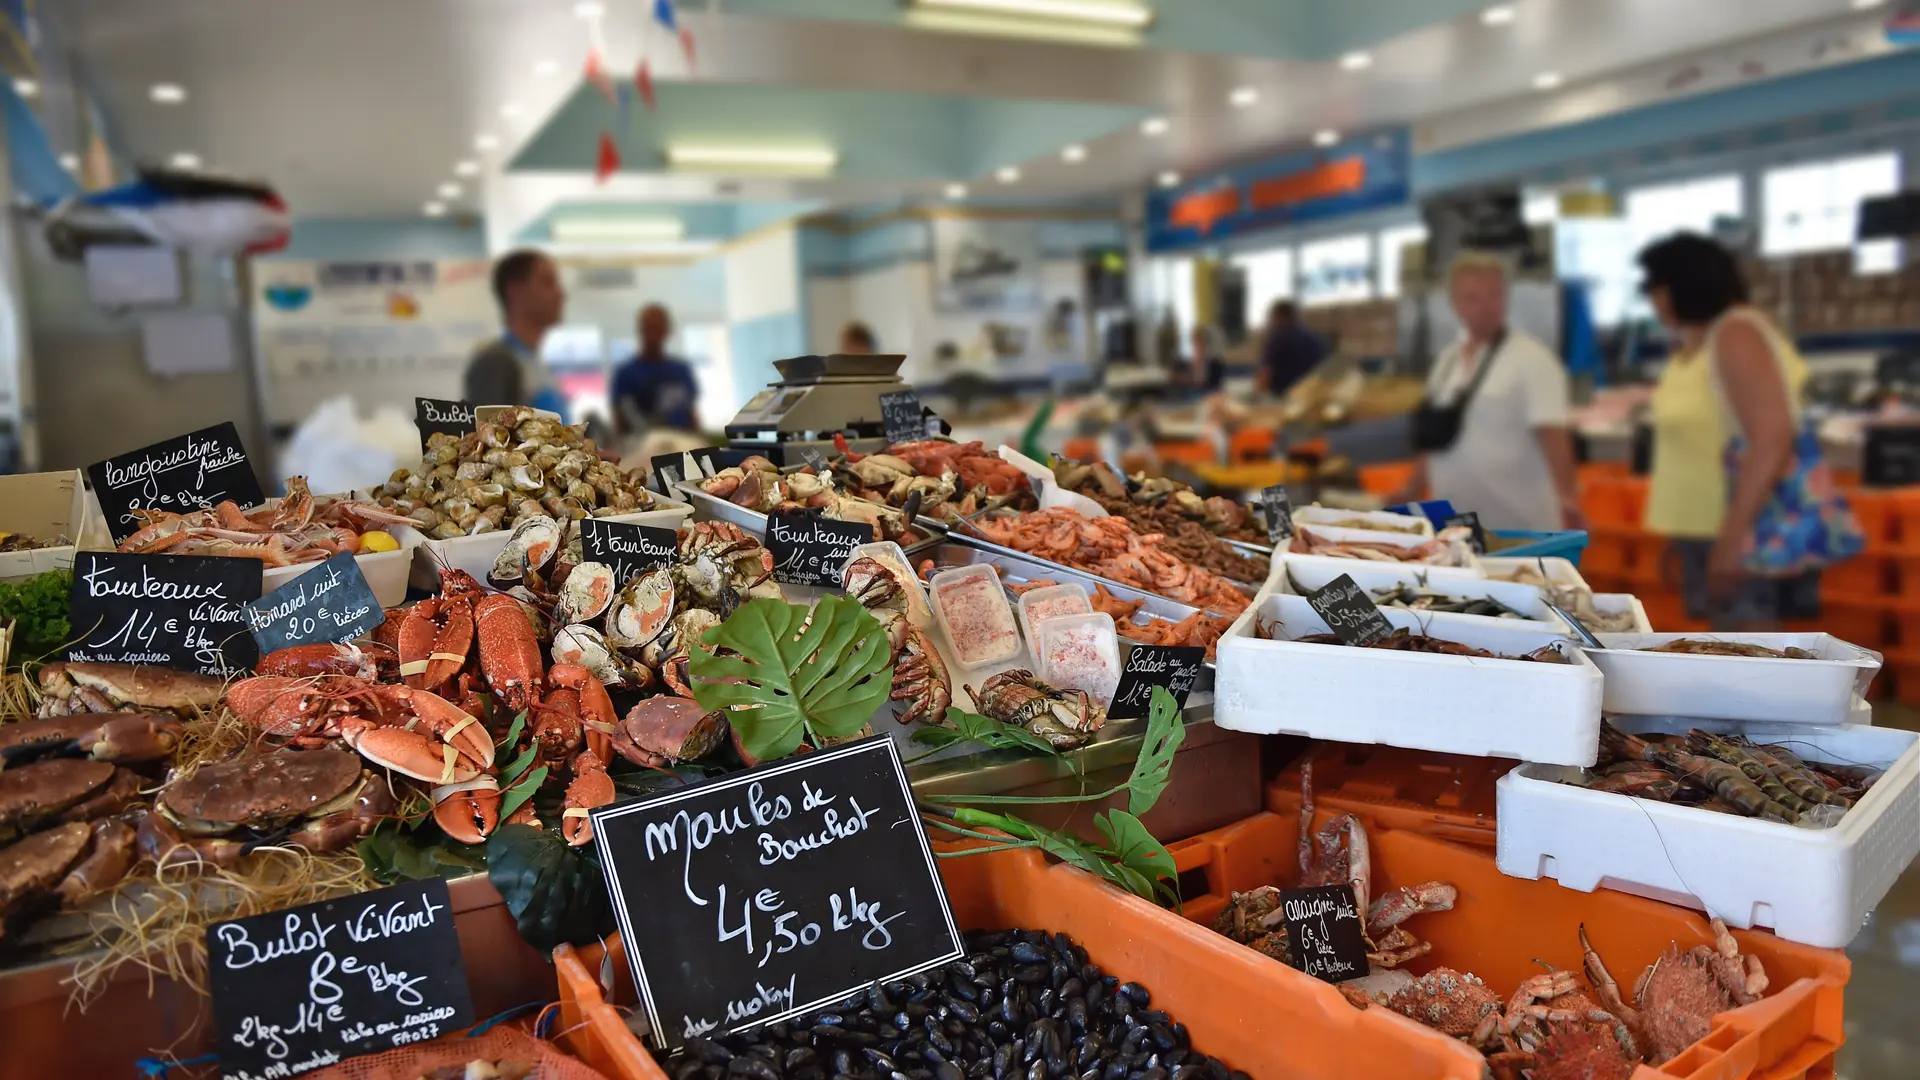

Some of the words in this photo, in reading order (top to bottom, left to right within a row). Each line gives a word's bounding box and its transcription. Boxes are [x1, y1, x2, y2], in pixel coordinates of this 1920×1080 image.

[105, 435, 220, 500] langoustine
[249, 584, 306, 632] Homard
[1126, 647, 1167, 673] Salade
[1169, 658, 1183, 667] au
[644, 781, 792, 906] Moules
[801, 780, 837, 812] de
[758, 797, 881, 866] Bouchot
[218, 912, 336, 969] Bulot
